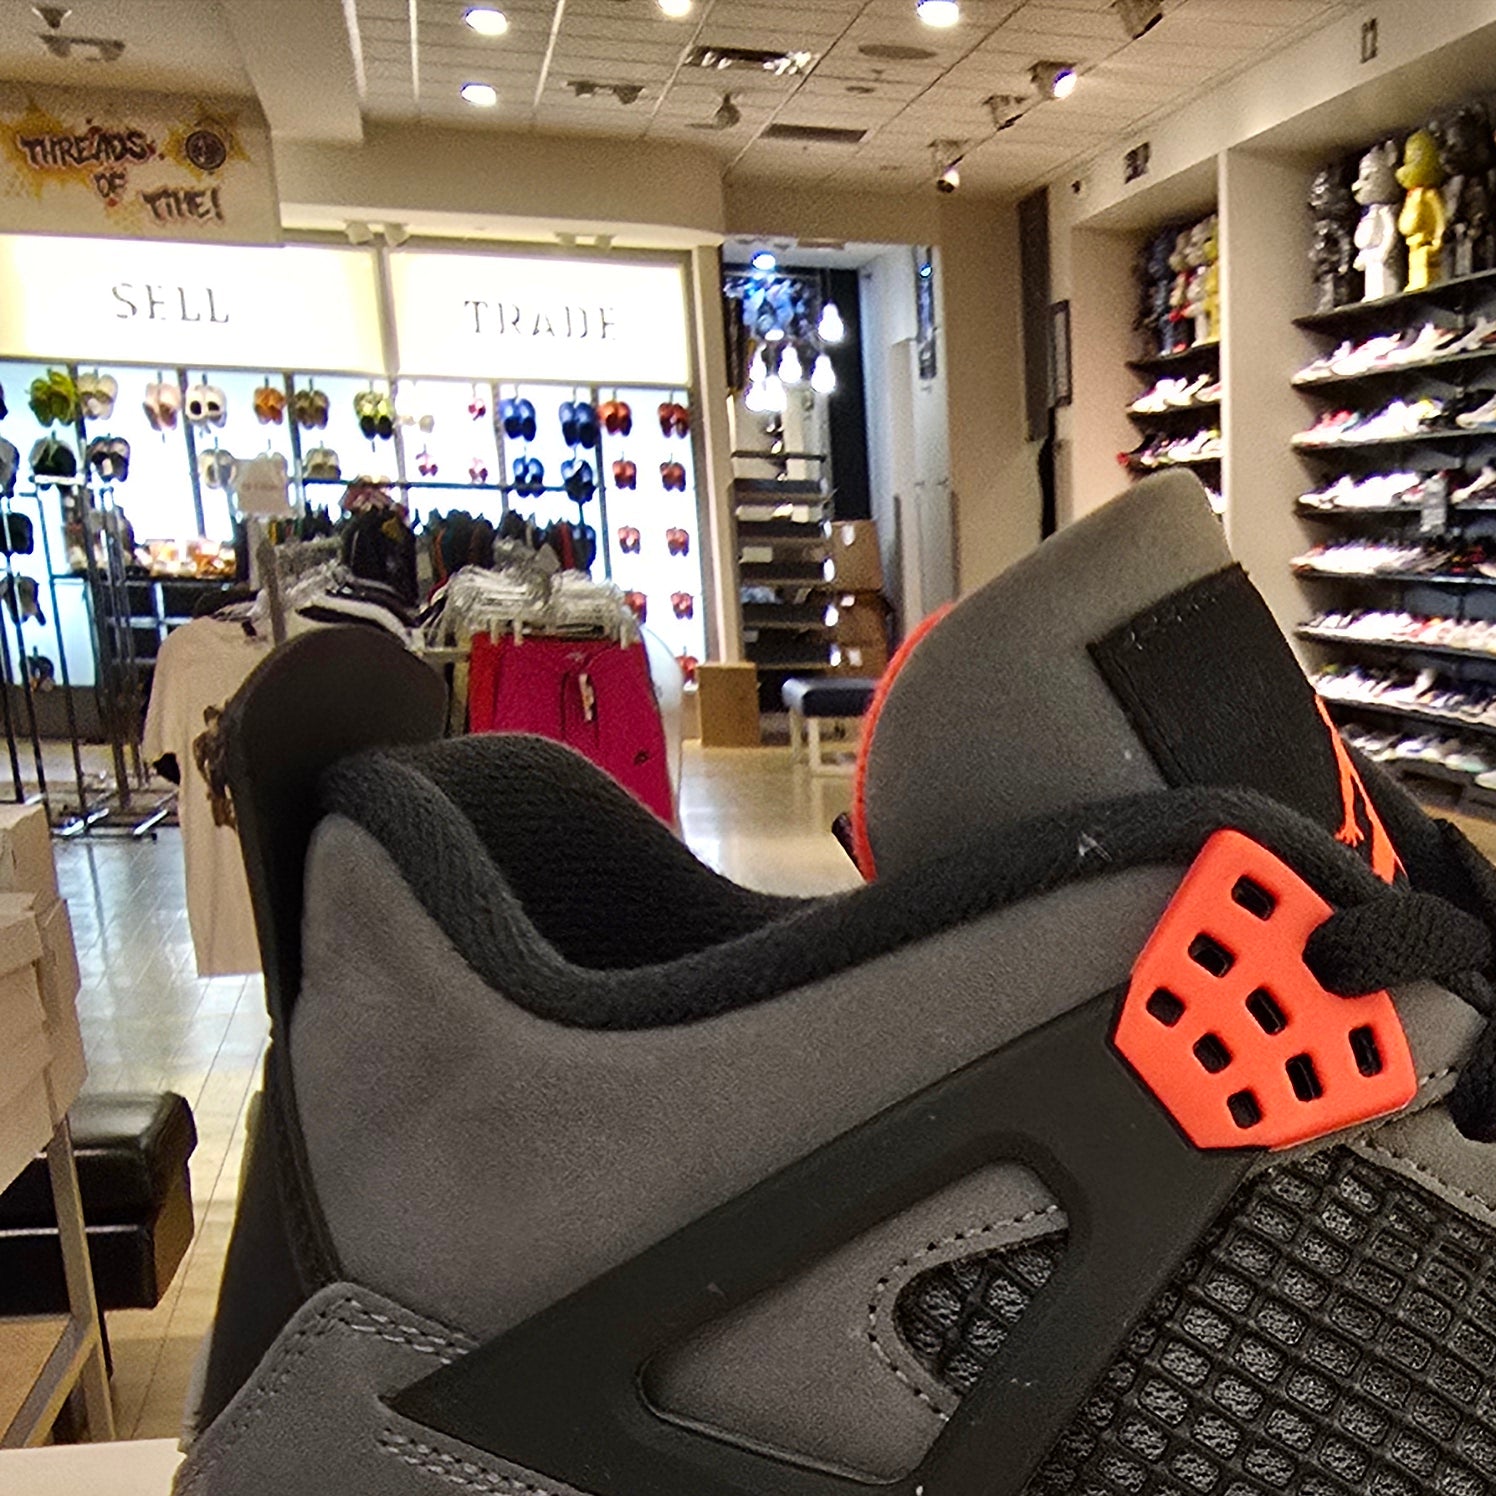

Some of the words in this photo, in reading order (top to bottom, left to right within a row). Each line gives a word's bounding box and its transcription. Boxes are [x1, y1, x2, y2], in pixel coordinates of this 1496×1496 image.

[19, 129, 150, 167] THREADS
[93, 170, 127, 198] OF
[112, 282, 229, 323] SELL
[464, 300, 616, 340] TRADE
